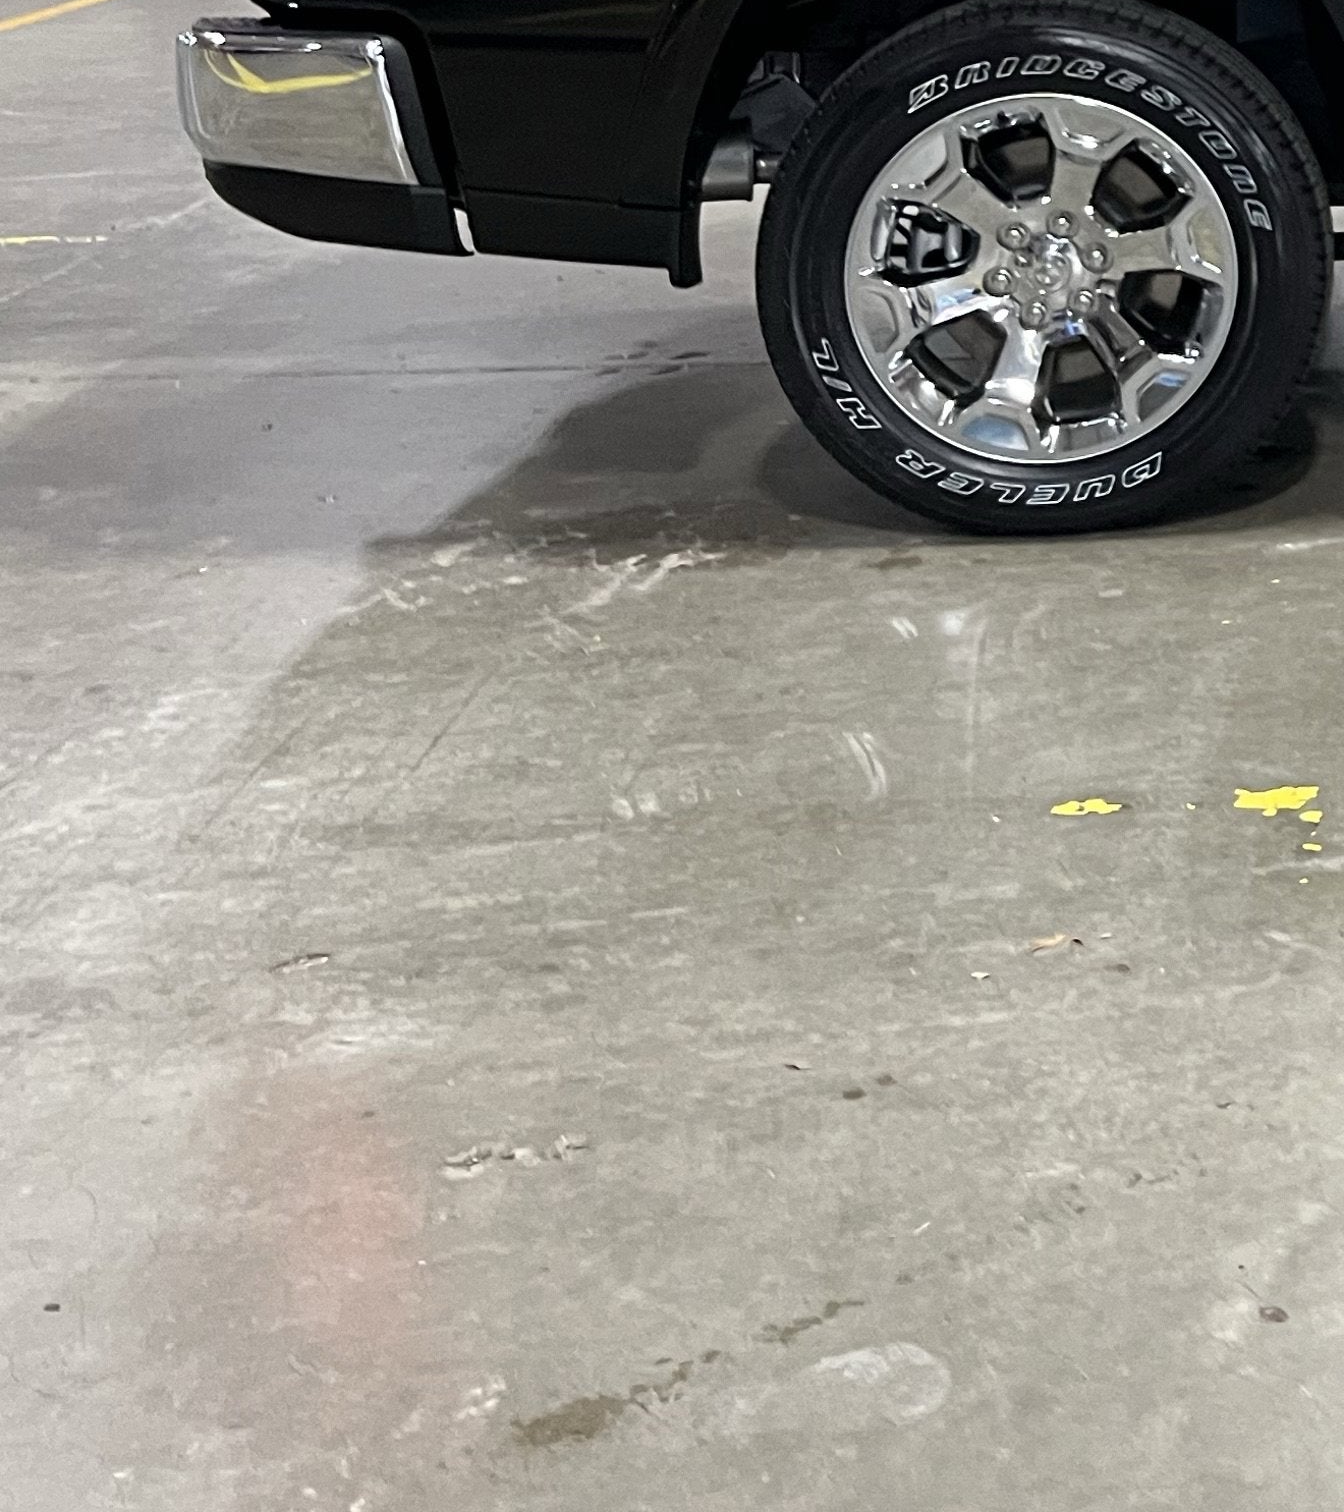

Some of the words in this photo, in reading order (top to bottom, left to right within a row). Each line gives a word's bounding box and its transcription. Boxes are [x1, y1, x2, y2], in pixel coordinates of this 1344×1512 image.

[907, 54, 1273, 231] BRIDGESTONE
[812, 337, 882, 431] H/L
[895, 450, 1163, 505] DUELER
